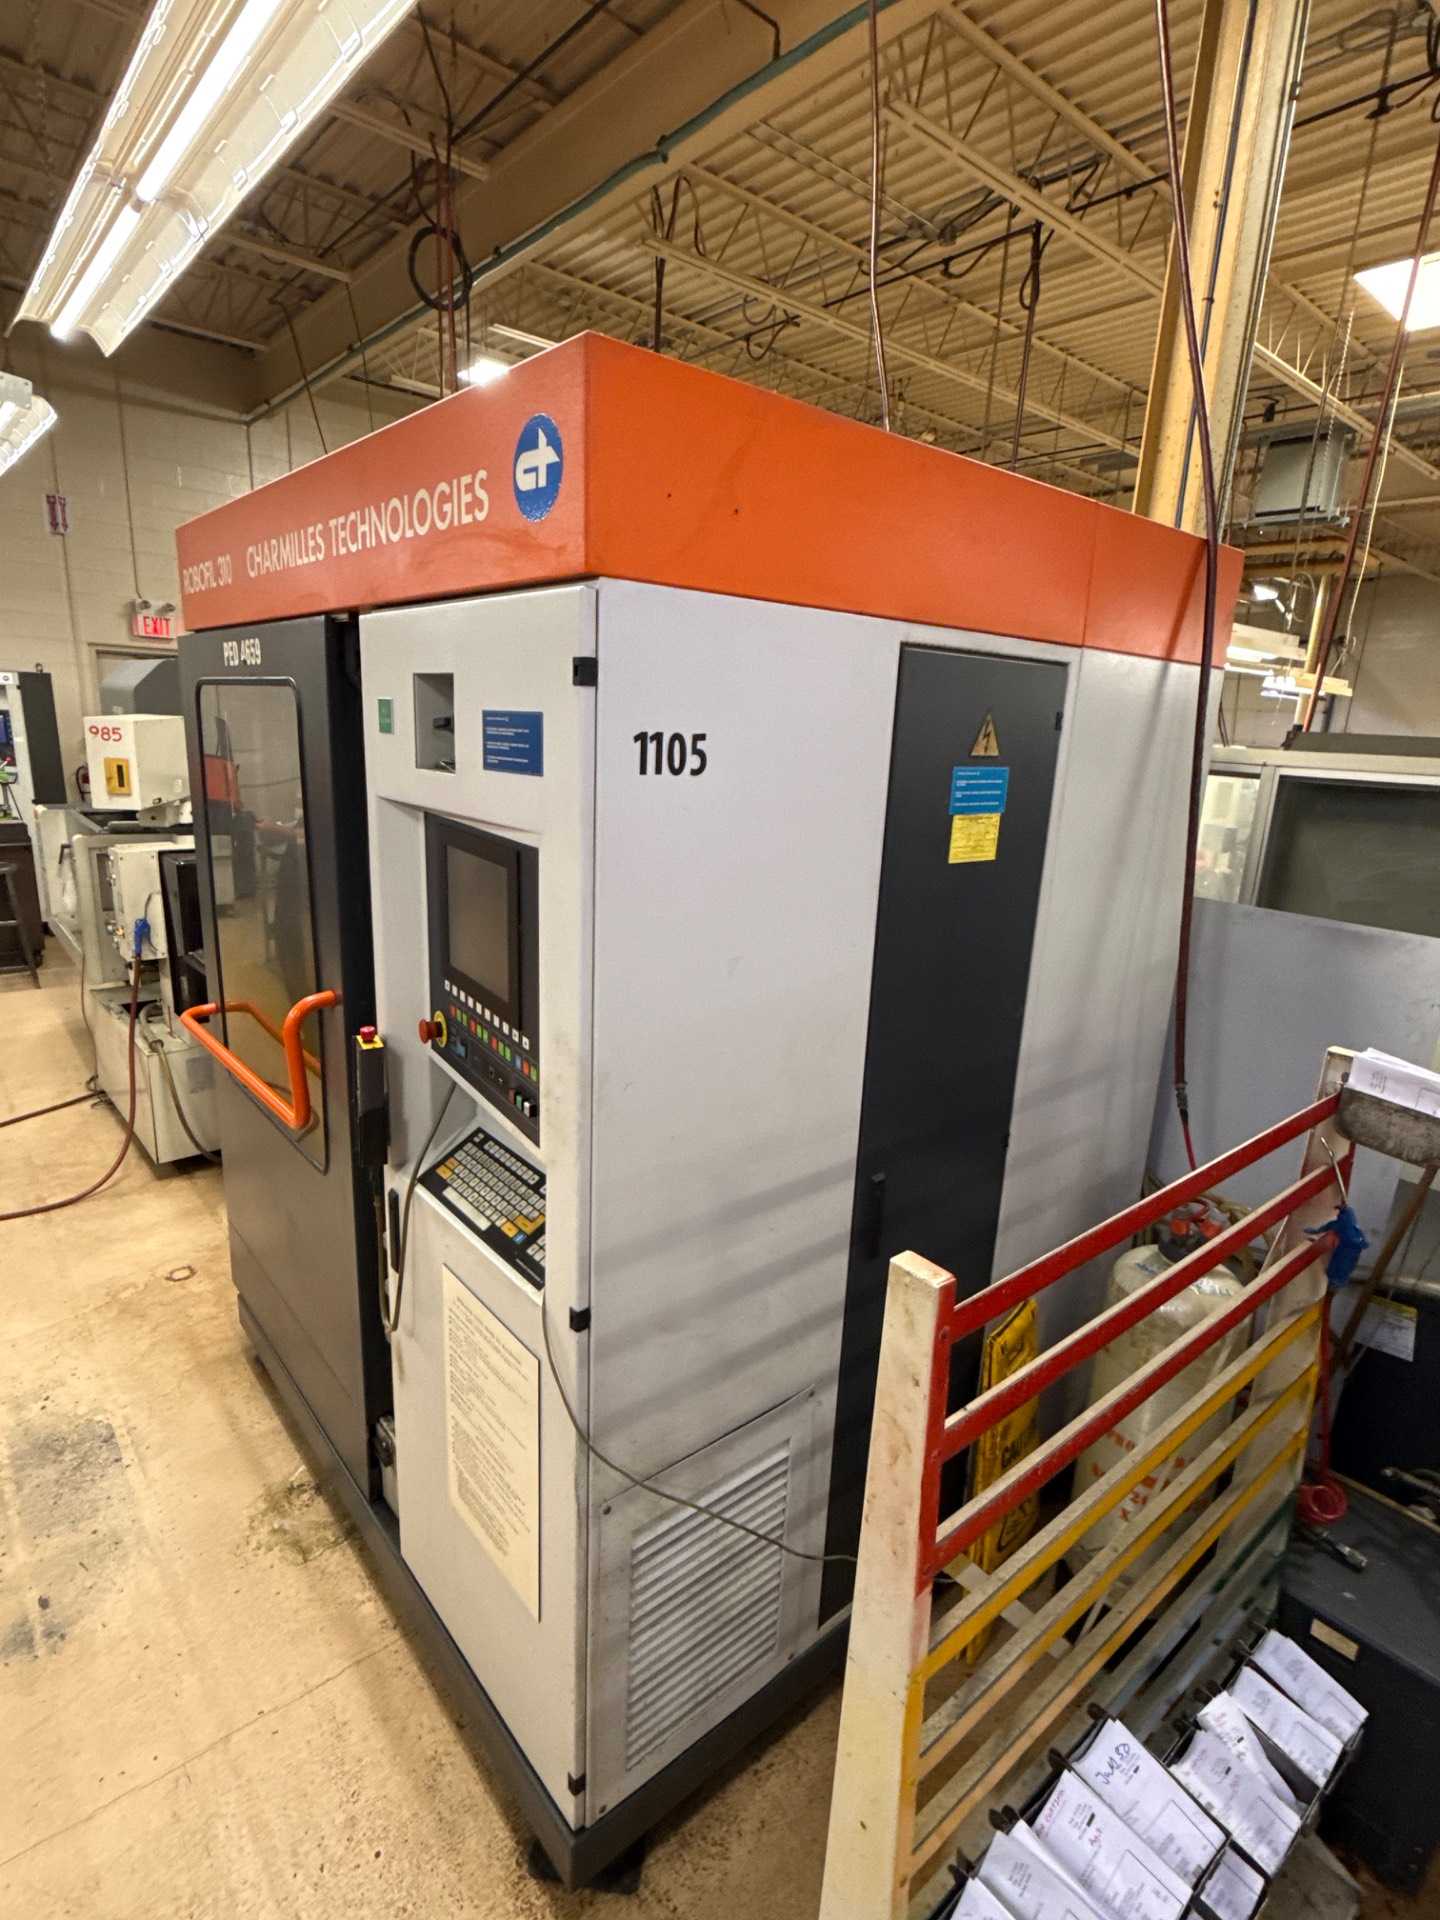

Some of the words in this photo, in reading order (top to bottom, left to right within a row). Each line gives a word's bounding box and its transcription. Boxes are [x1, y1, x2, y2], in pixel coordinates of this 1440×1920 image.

[246, 522, 325, 578] CHARMILLES
[328, 468, 490, 557] TECHNOLOGIES
[143, 616, 170, 637] EXIT
[223, 641, 239, 667] PED
[89, 725, 122, 742] 985
[633, 731, 708, 777] 1105
